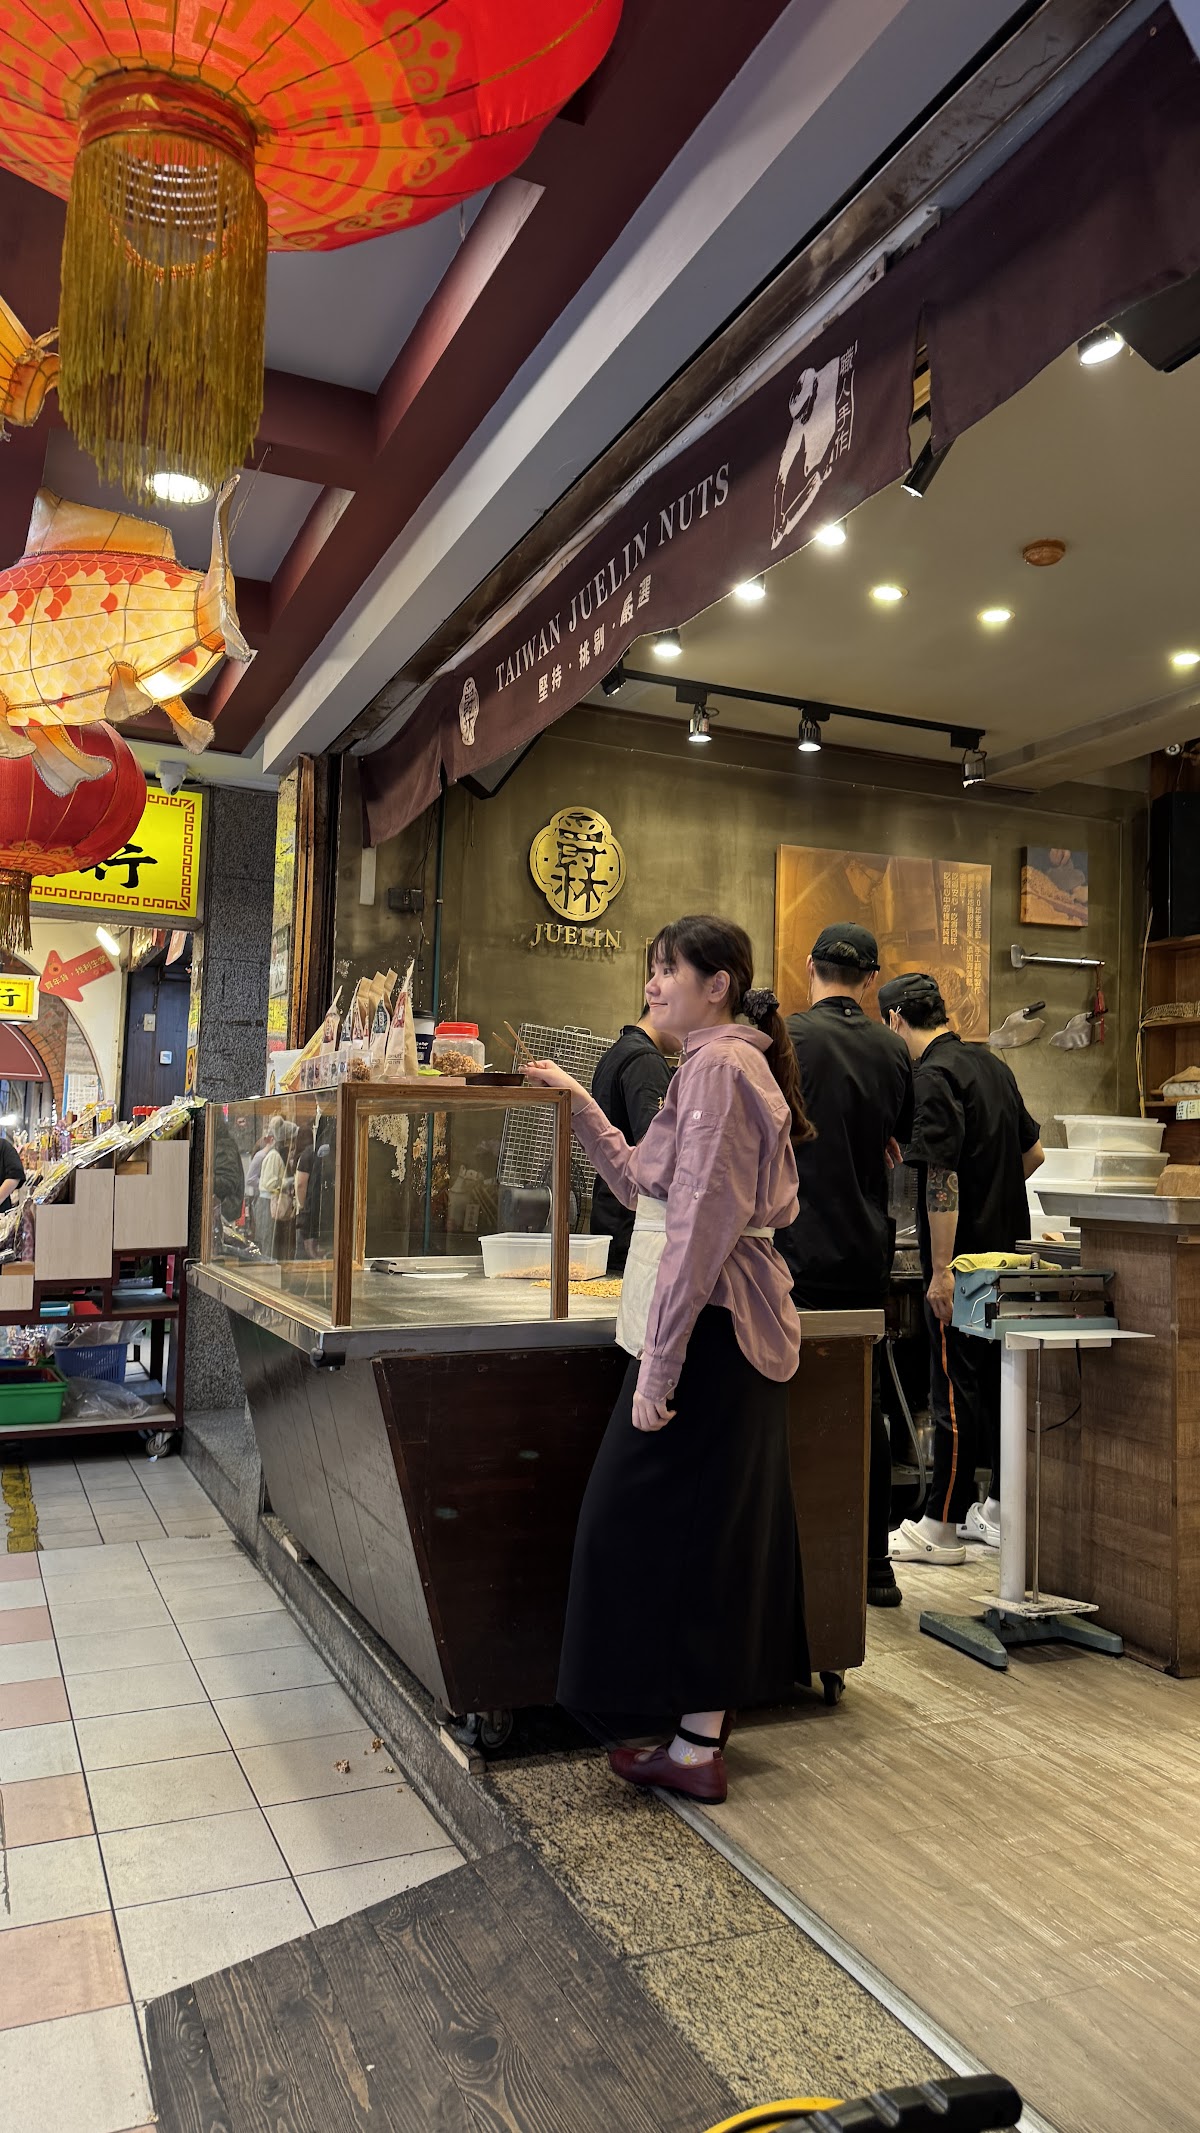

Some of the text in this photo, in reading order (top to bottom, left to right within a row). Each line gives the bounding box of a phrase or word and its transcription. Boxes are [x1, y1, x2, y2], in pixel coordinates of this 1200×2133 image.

[836, 346, 854, 460] 職人手作
[495, 462, 730, 692] TAIWAN JUELIN NUTS
[72, 842, 158, 889] 行
[529, 923, 622, 949] JUELIN
